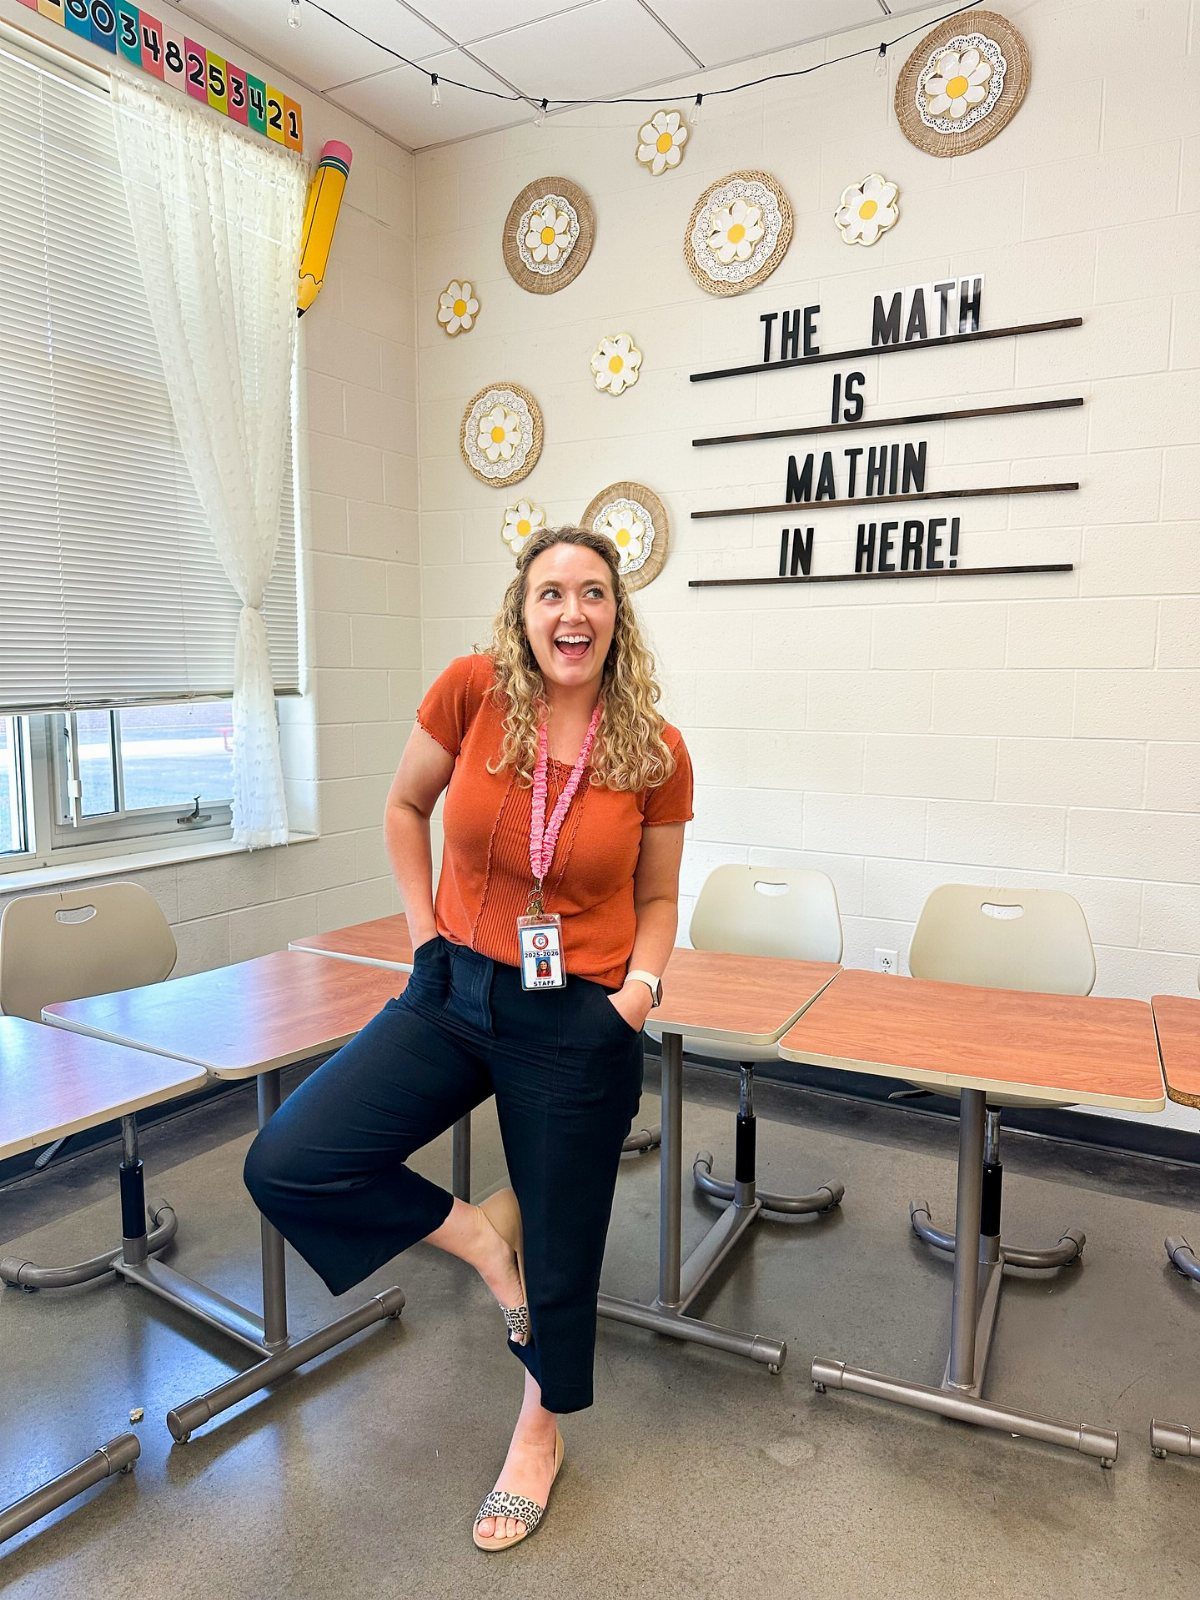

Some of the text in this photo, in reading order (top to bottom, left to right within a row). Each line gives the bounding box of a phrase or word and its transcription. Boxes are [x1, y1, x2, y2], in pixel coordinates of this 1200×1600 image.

[760, 278, 982, 362] THE MATH
[831, 372, 866, 424] IS
[785, 441, 928, 503] MATHIN
[779, 517, 960, 576] IN HERE!
[524, 950, 559, 958] 2025-2026
